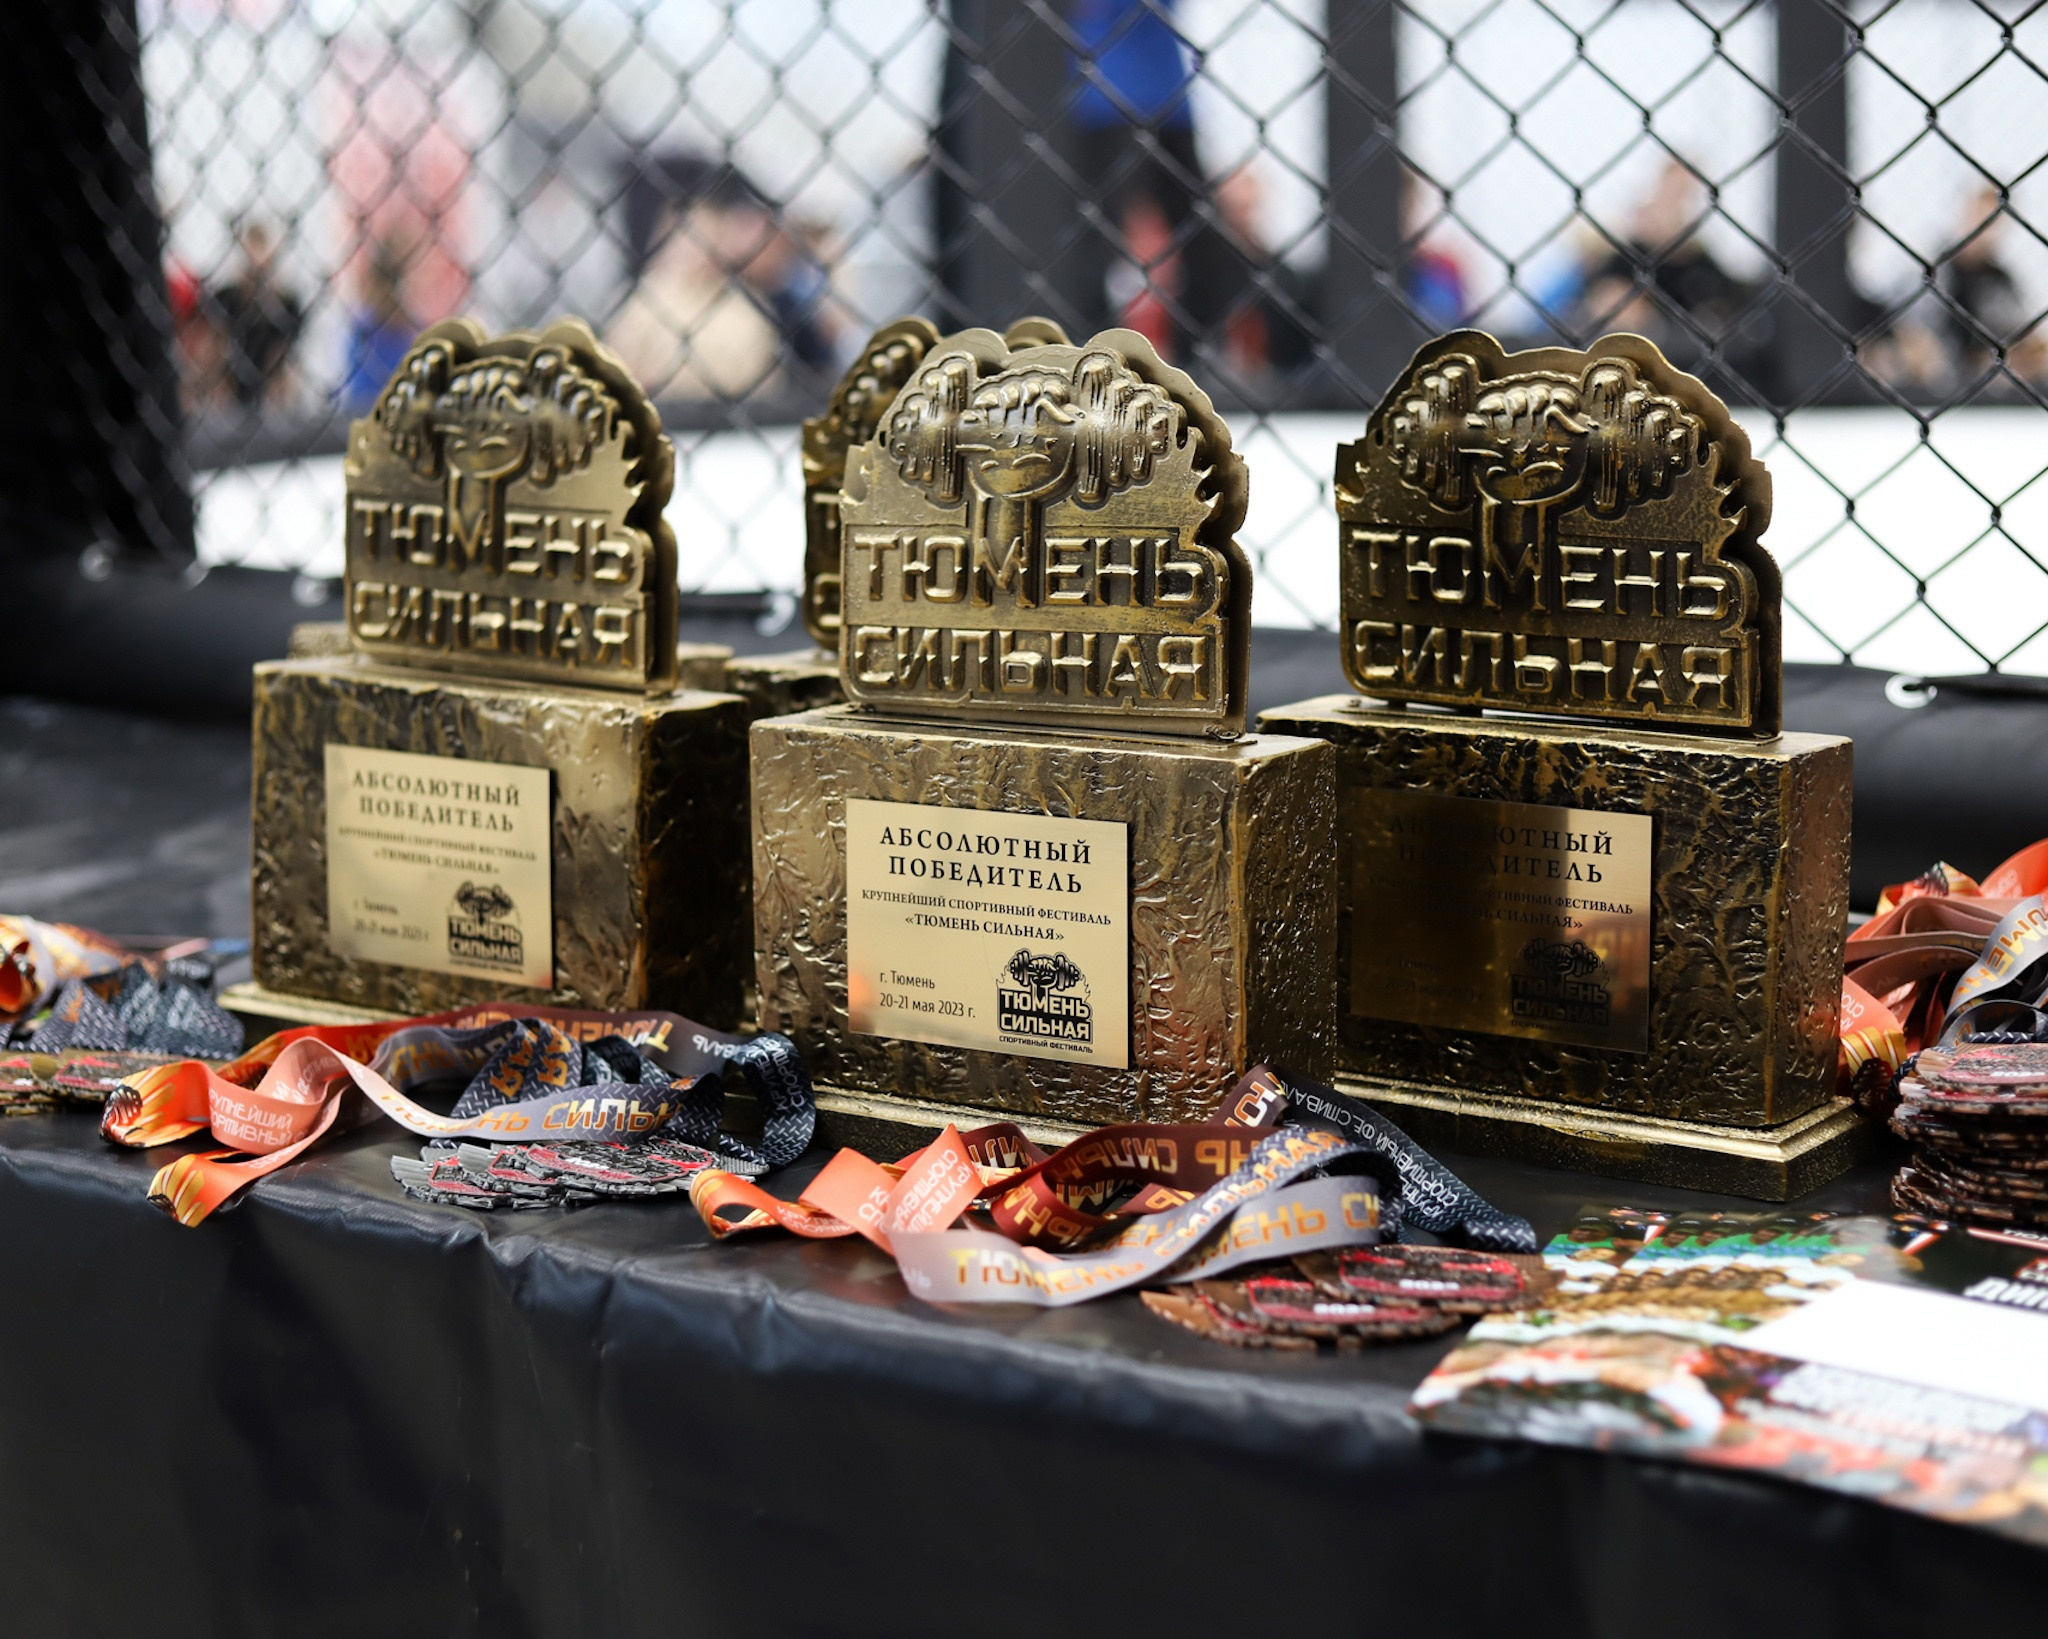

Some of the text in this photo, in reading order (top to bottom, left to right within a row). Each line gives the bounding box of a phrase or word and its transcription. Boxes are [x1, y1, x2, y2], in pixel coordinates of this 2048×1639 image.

[353, 496, 636, 585] ТЮМЕНЬ
[854, 531, 1205, 609] ТЮМЕНЬ
[1351, 530, 1729, 619] ТЮМЕНЬ
[352, 581, 634, 669] СИЛЬНАЯ
[854, 625, 1206, 700] СИЛЬНАЯ
[1355, 620, 1733, 711] СИЛЬНАЯ
[353, 769, 521, 807] АБСОЛЮТНЫЙ
[359, 796, 514, 832] ПОБЕДИТЕЛЬ
[880, 826, 1091, 865] АБСОЛЮТНЫЙ
[888, 855, 1082, 894] ПОБЕДИТЕЛЬ
[861, 889, 1111, 926] КРУПНЕЙШИЙ СПОРТИВНЫЙ ФЕСТИВАЛЬ
[1554, 895, 1634, 916] ФЕСТИВАЛЬ
[905, 913, 1065, 941] «ТЮМЕНЬ СИЛЬНАЯ»
[879, 970, 936, 990] г. Тюмень
[879, 993, 909, 1010] 20-21
[911, 998, 935, 1014] мая
[937, 999, 964, 1017] 2023
[1001, 989, 1090, 1018] ТЮМЕНЬ
[998, 1035, 1093, 1054] СПОРТИВНЫЙ ФЕСТИВАЛЬ
[1001, 1012, 1090, 1040] СИЛЬНАЯ
